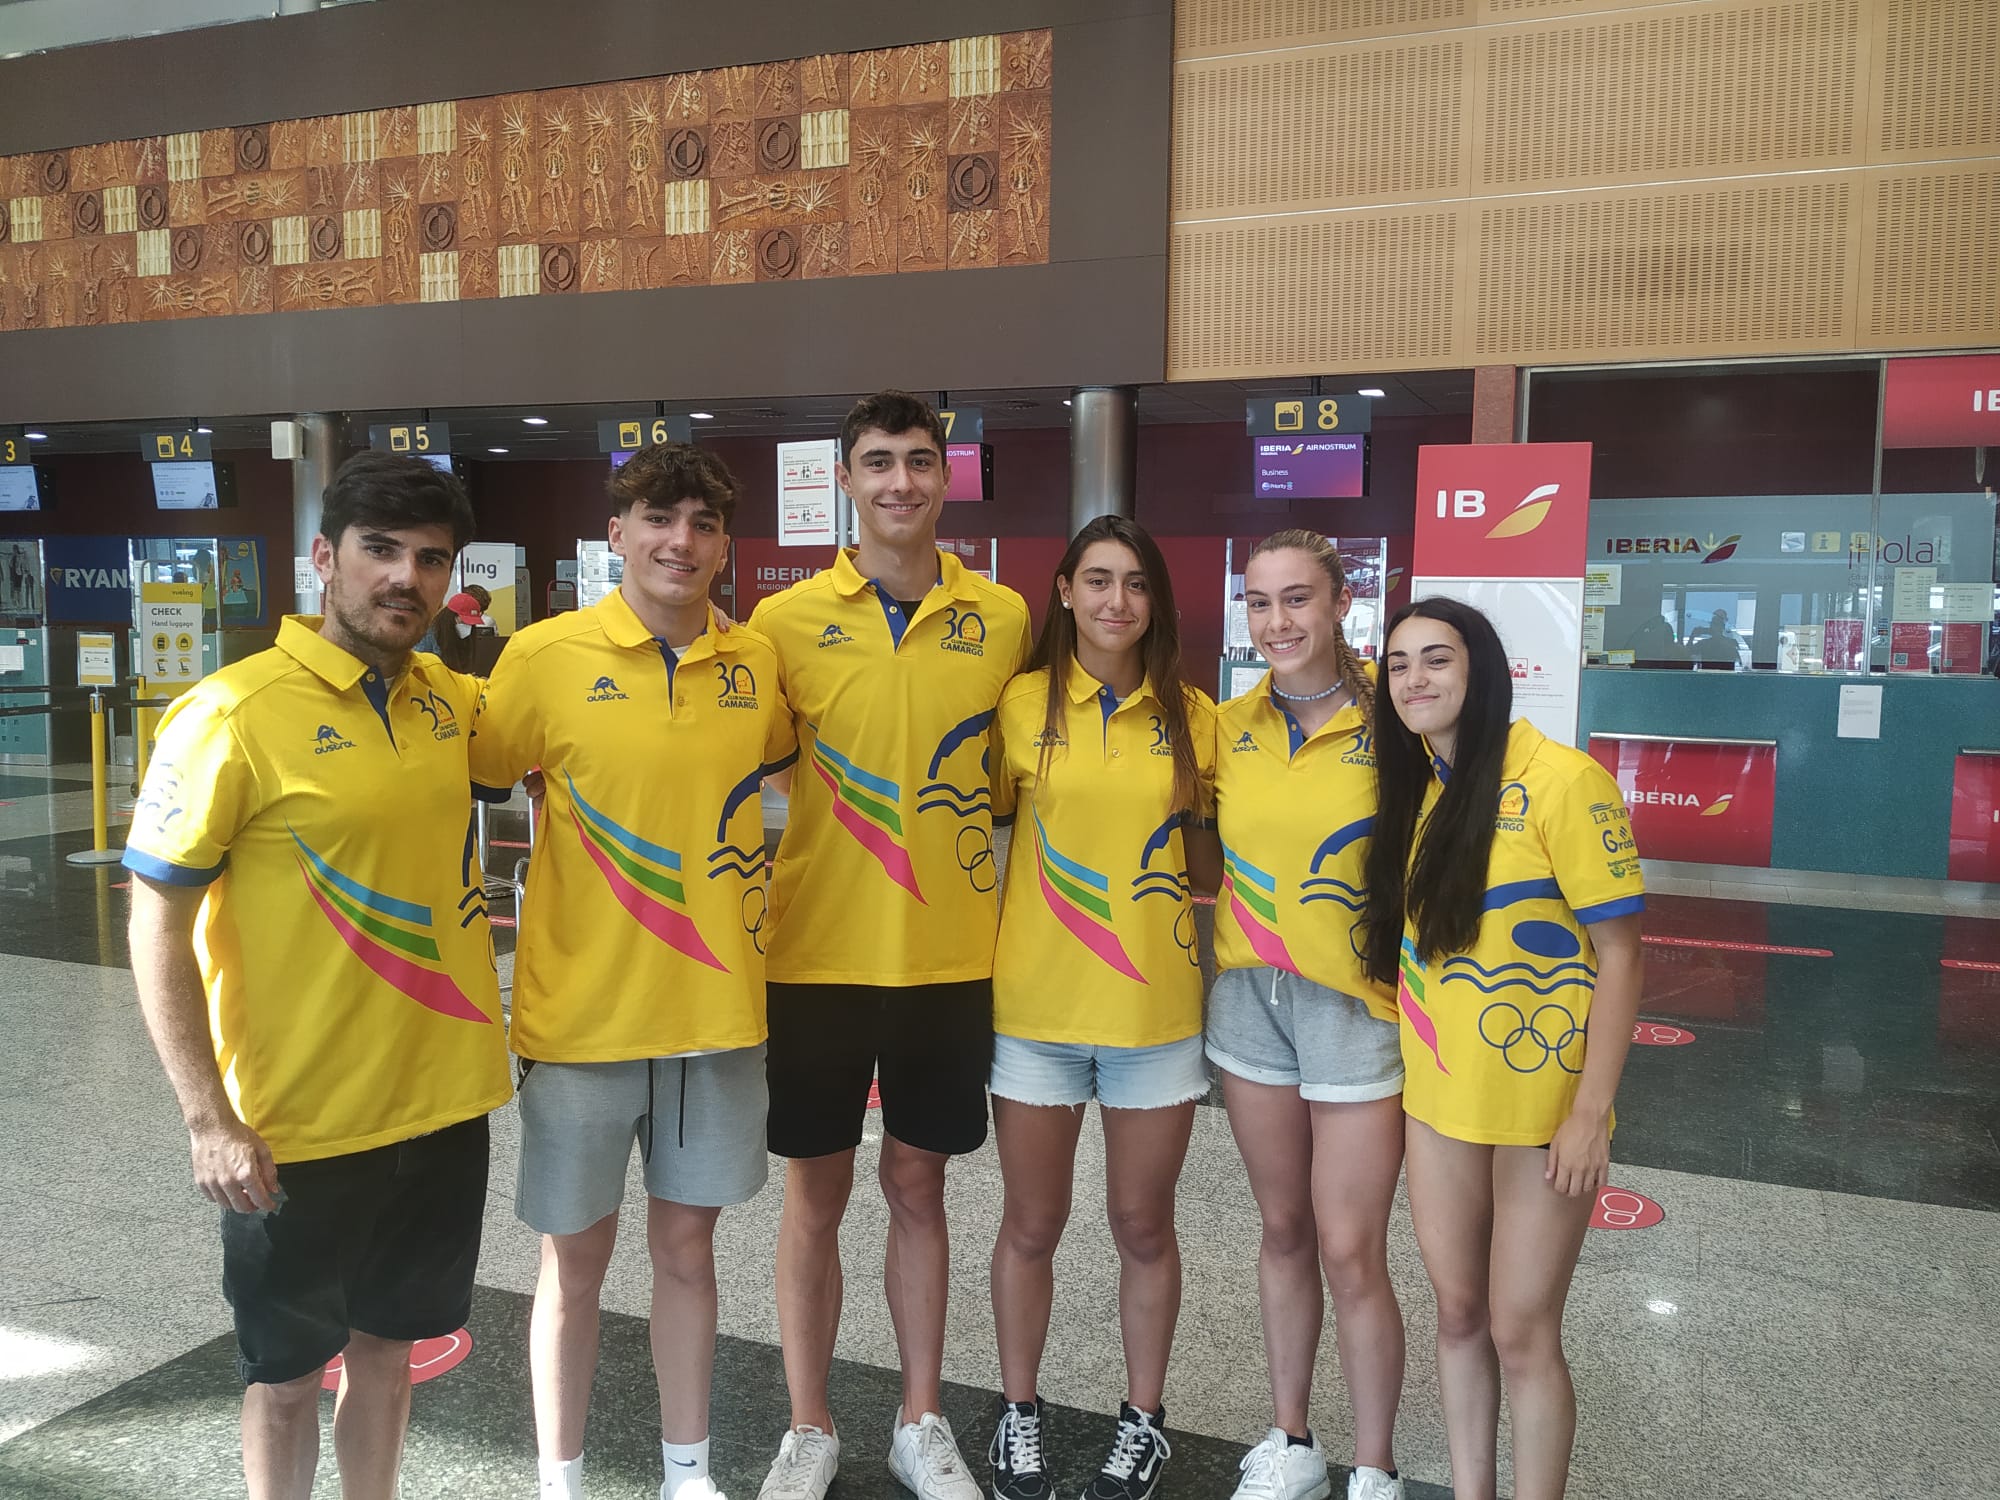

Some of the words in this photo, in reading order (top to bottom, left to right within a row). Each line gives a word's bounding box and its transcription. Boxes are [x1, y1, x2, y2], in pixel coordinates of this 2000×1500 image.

[1318, 399, 1339, 430] 8
[651, 420, 668, 445] 6
[940, 412, 956, 440] 7
[180, 435, 193, 457] 4
[415, 425, 430, 451] 5
[5, 440, 16, 462] 3
[1436, 489, 1486, 518] IB
[1606, 537, 1702, 554] IBERIA
[65, 568, 130, 588] RYAN
[461, 557, 497, 579] ling
[151, 608, 182, 616] CHECK
[171, 620, 194, 628] luggage
[941, 607, 986, 644] 30
[940, 642, 984, 657] CAMARGO
[714, 661, 756, 698] 30
[718, 699, 759, 710] CAMARGO
[1150, 748, 1174, 757] CAM
[1623, 790, 1700, 807] IBERIA
